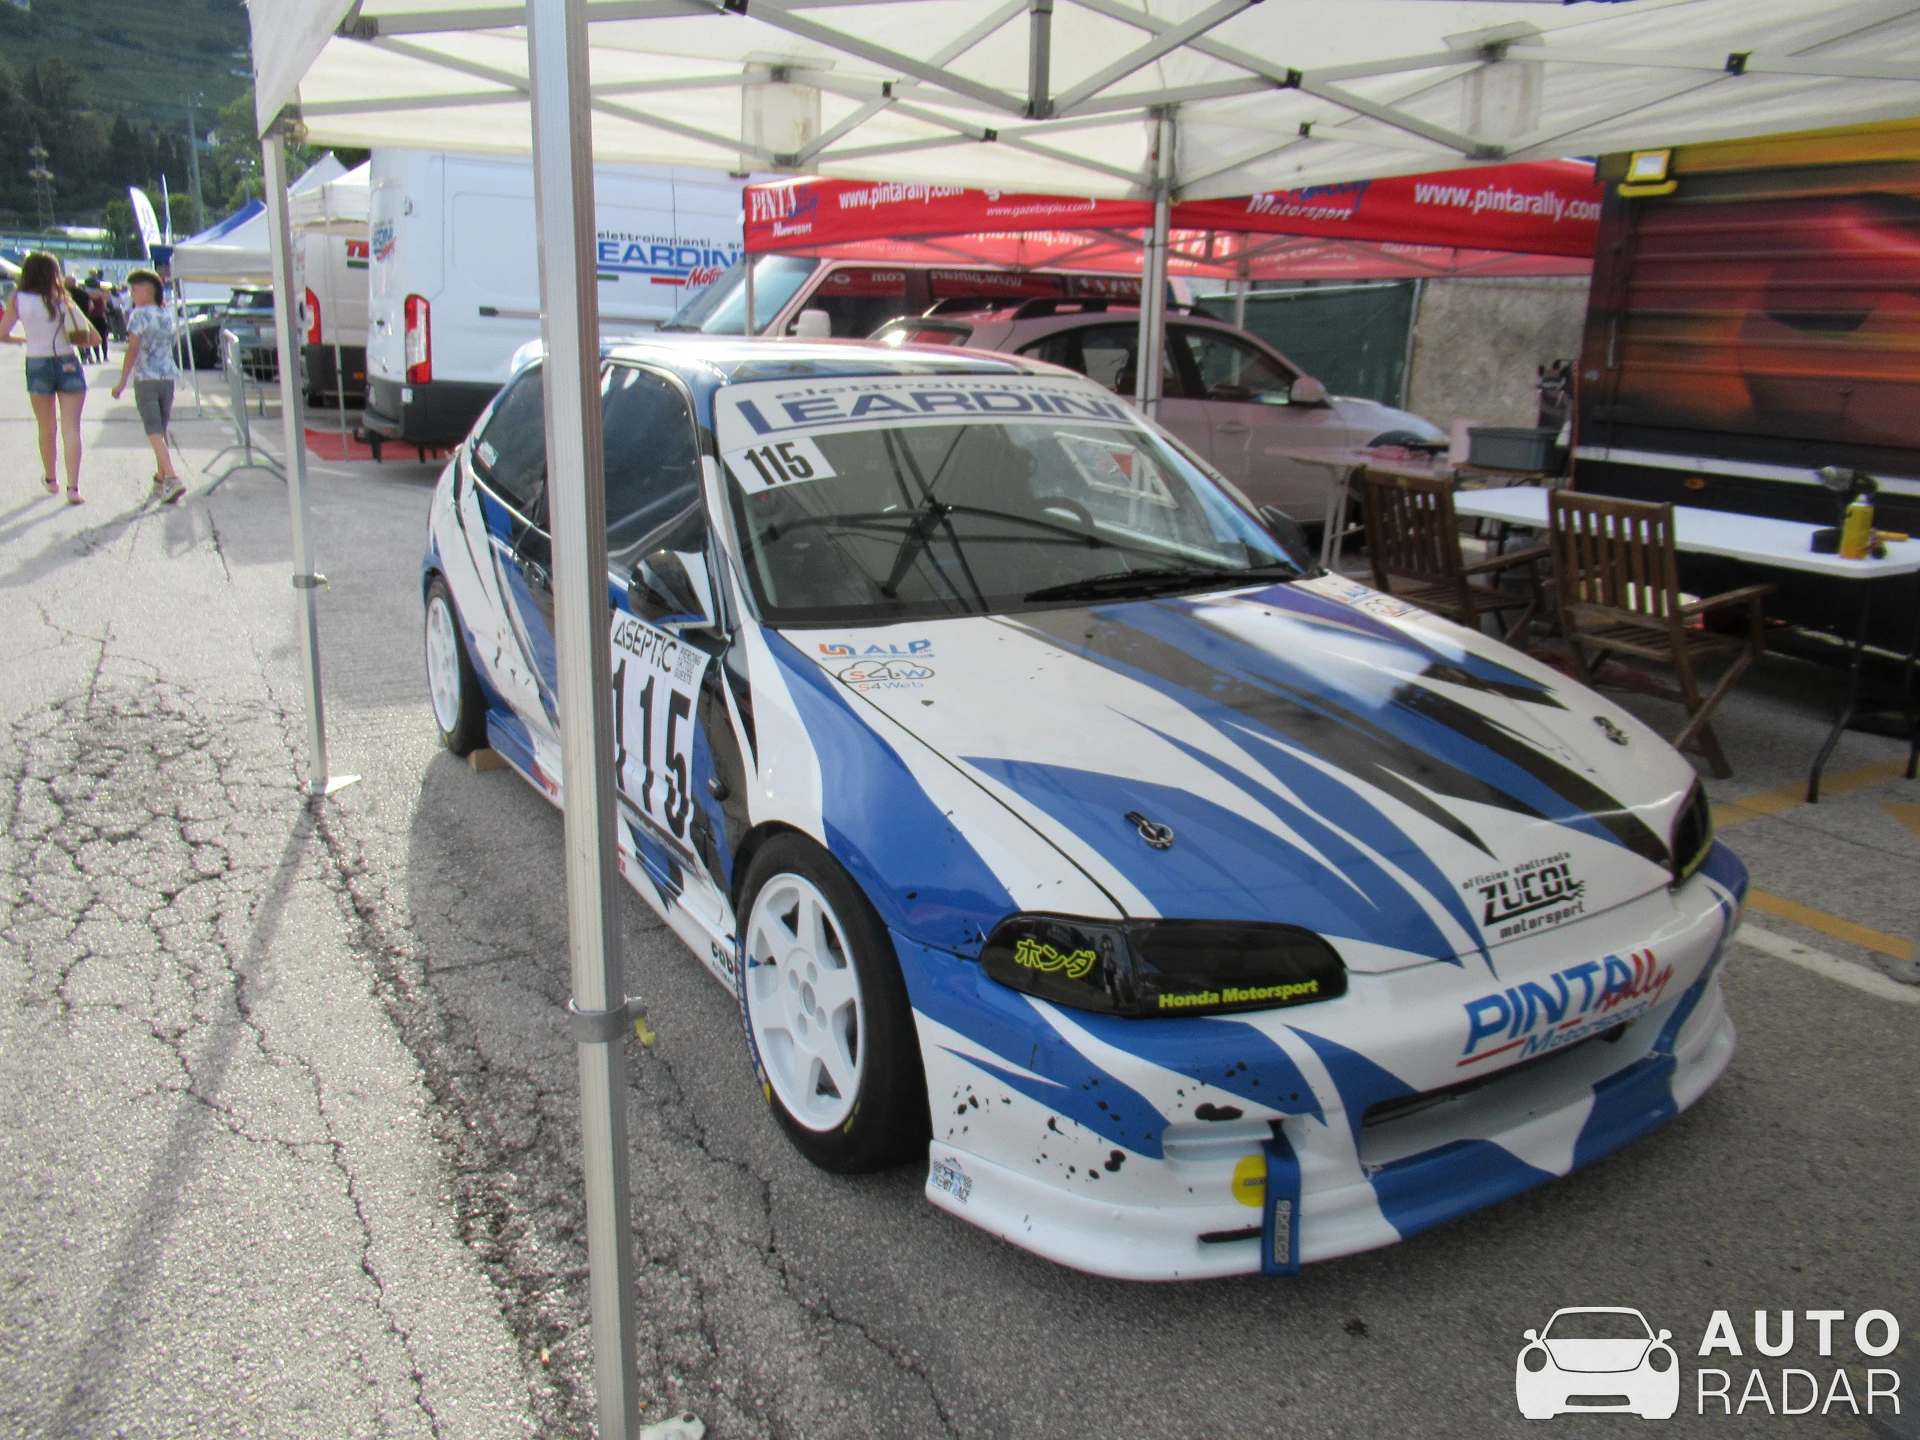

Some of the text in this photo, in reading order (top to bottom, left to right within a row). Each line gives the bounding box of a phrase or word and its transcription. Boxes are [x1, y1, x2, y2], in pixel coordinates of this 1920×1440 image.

[1247, 193, 1353, 221] Motorsport
[597, 230, 711, 247] elettroimpianti
[598, 241, 744, 268] EARDIN
[735, 390, 1132, 436] LEARDINI
[744, 441, 814, 486] 115
[613, 616, 677, 673] ASEPTIC
[863, 639, 932, 655] ALP
[612, 658, 691, 839] 115
[1500, 900, 1585, 939] motorsport
[1014, 939, 1096, 979] ホンダ
[1158, 979, 1319, 1009] Honda Motorsport
[1463, 954, 1634, 1056] PINTA
